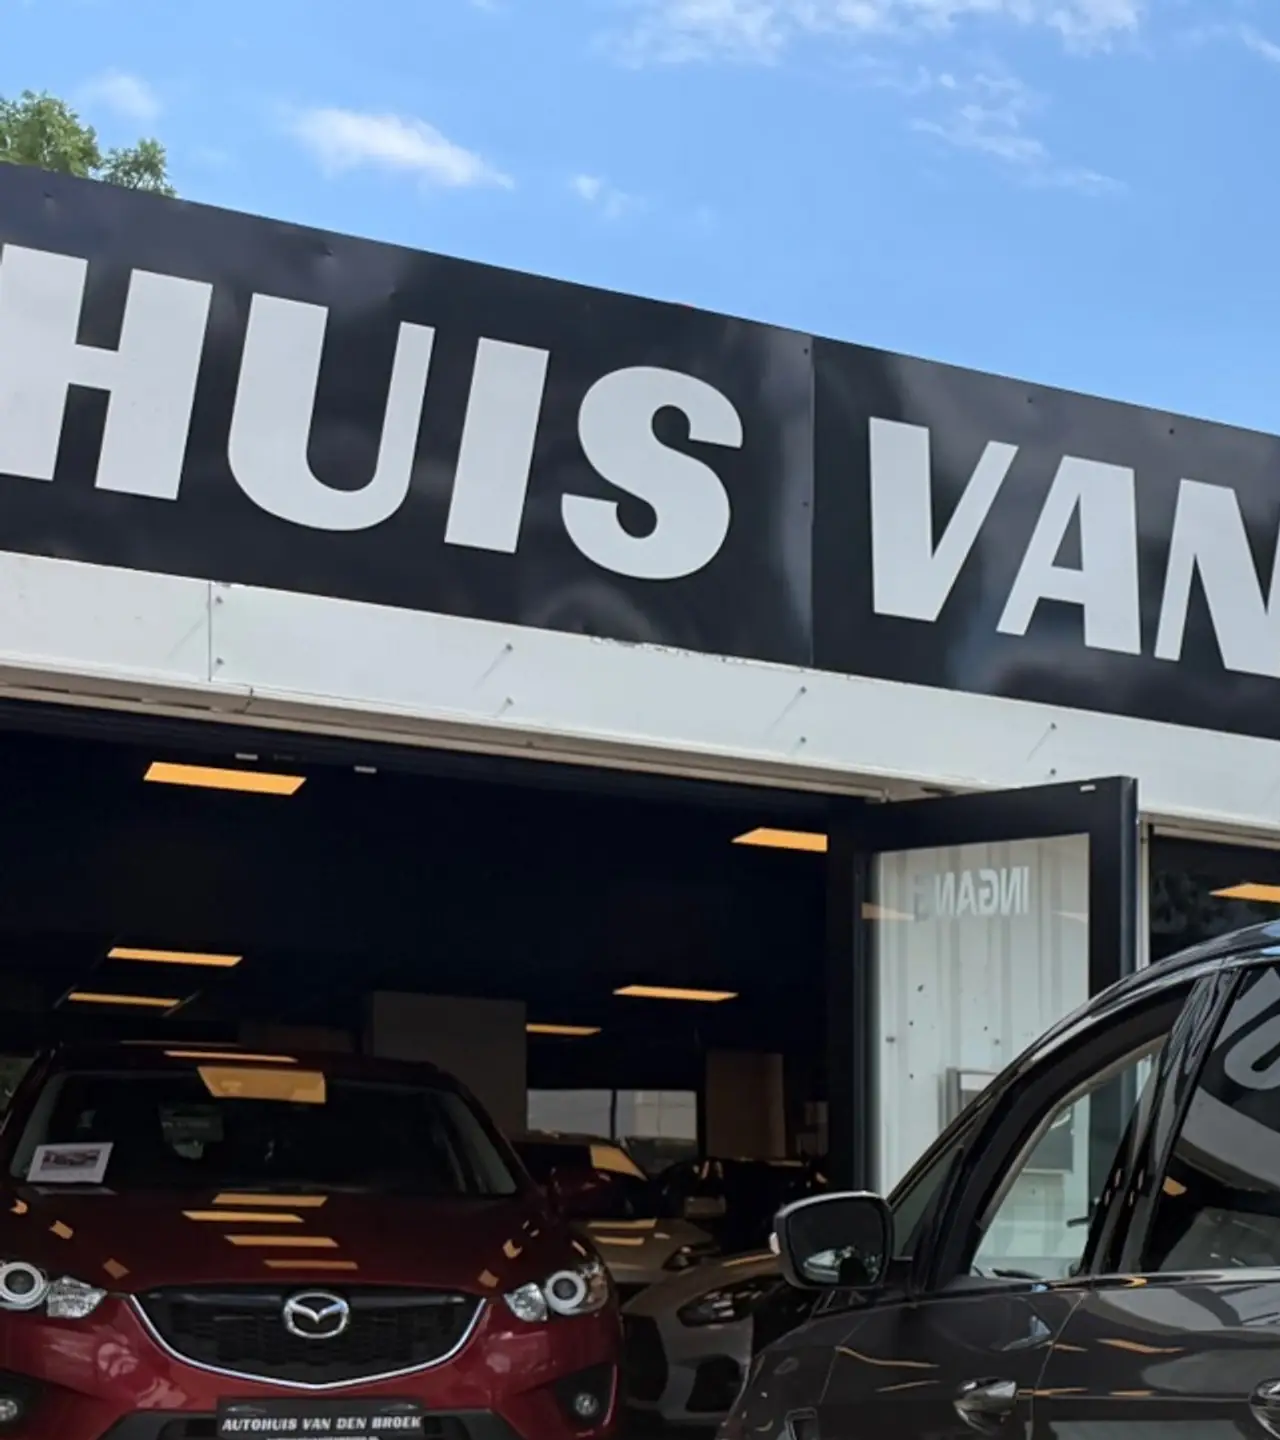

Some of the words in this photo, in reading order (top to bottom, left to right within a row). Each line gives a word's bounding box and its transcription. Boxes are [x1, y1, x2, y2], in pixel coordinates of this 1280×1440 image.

[0, 243, 744, 580] HUIS
[222, 1417, 298, 1432] AUTOHUIS
[302, 1417, 331, 1431] VAN
[336, 1416, 367, 1430] DEN
